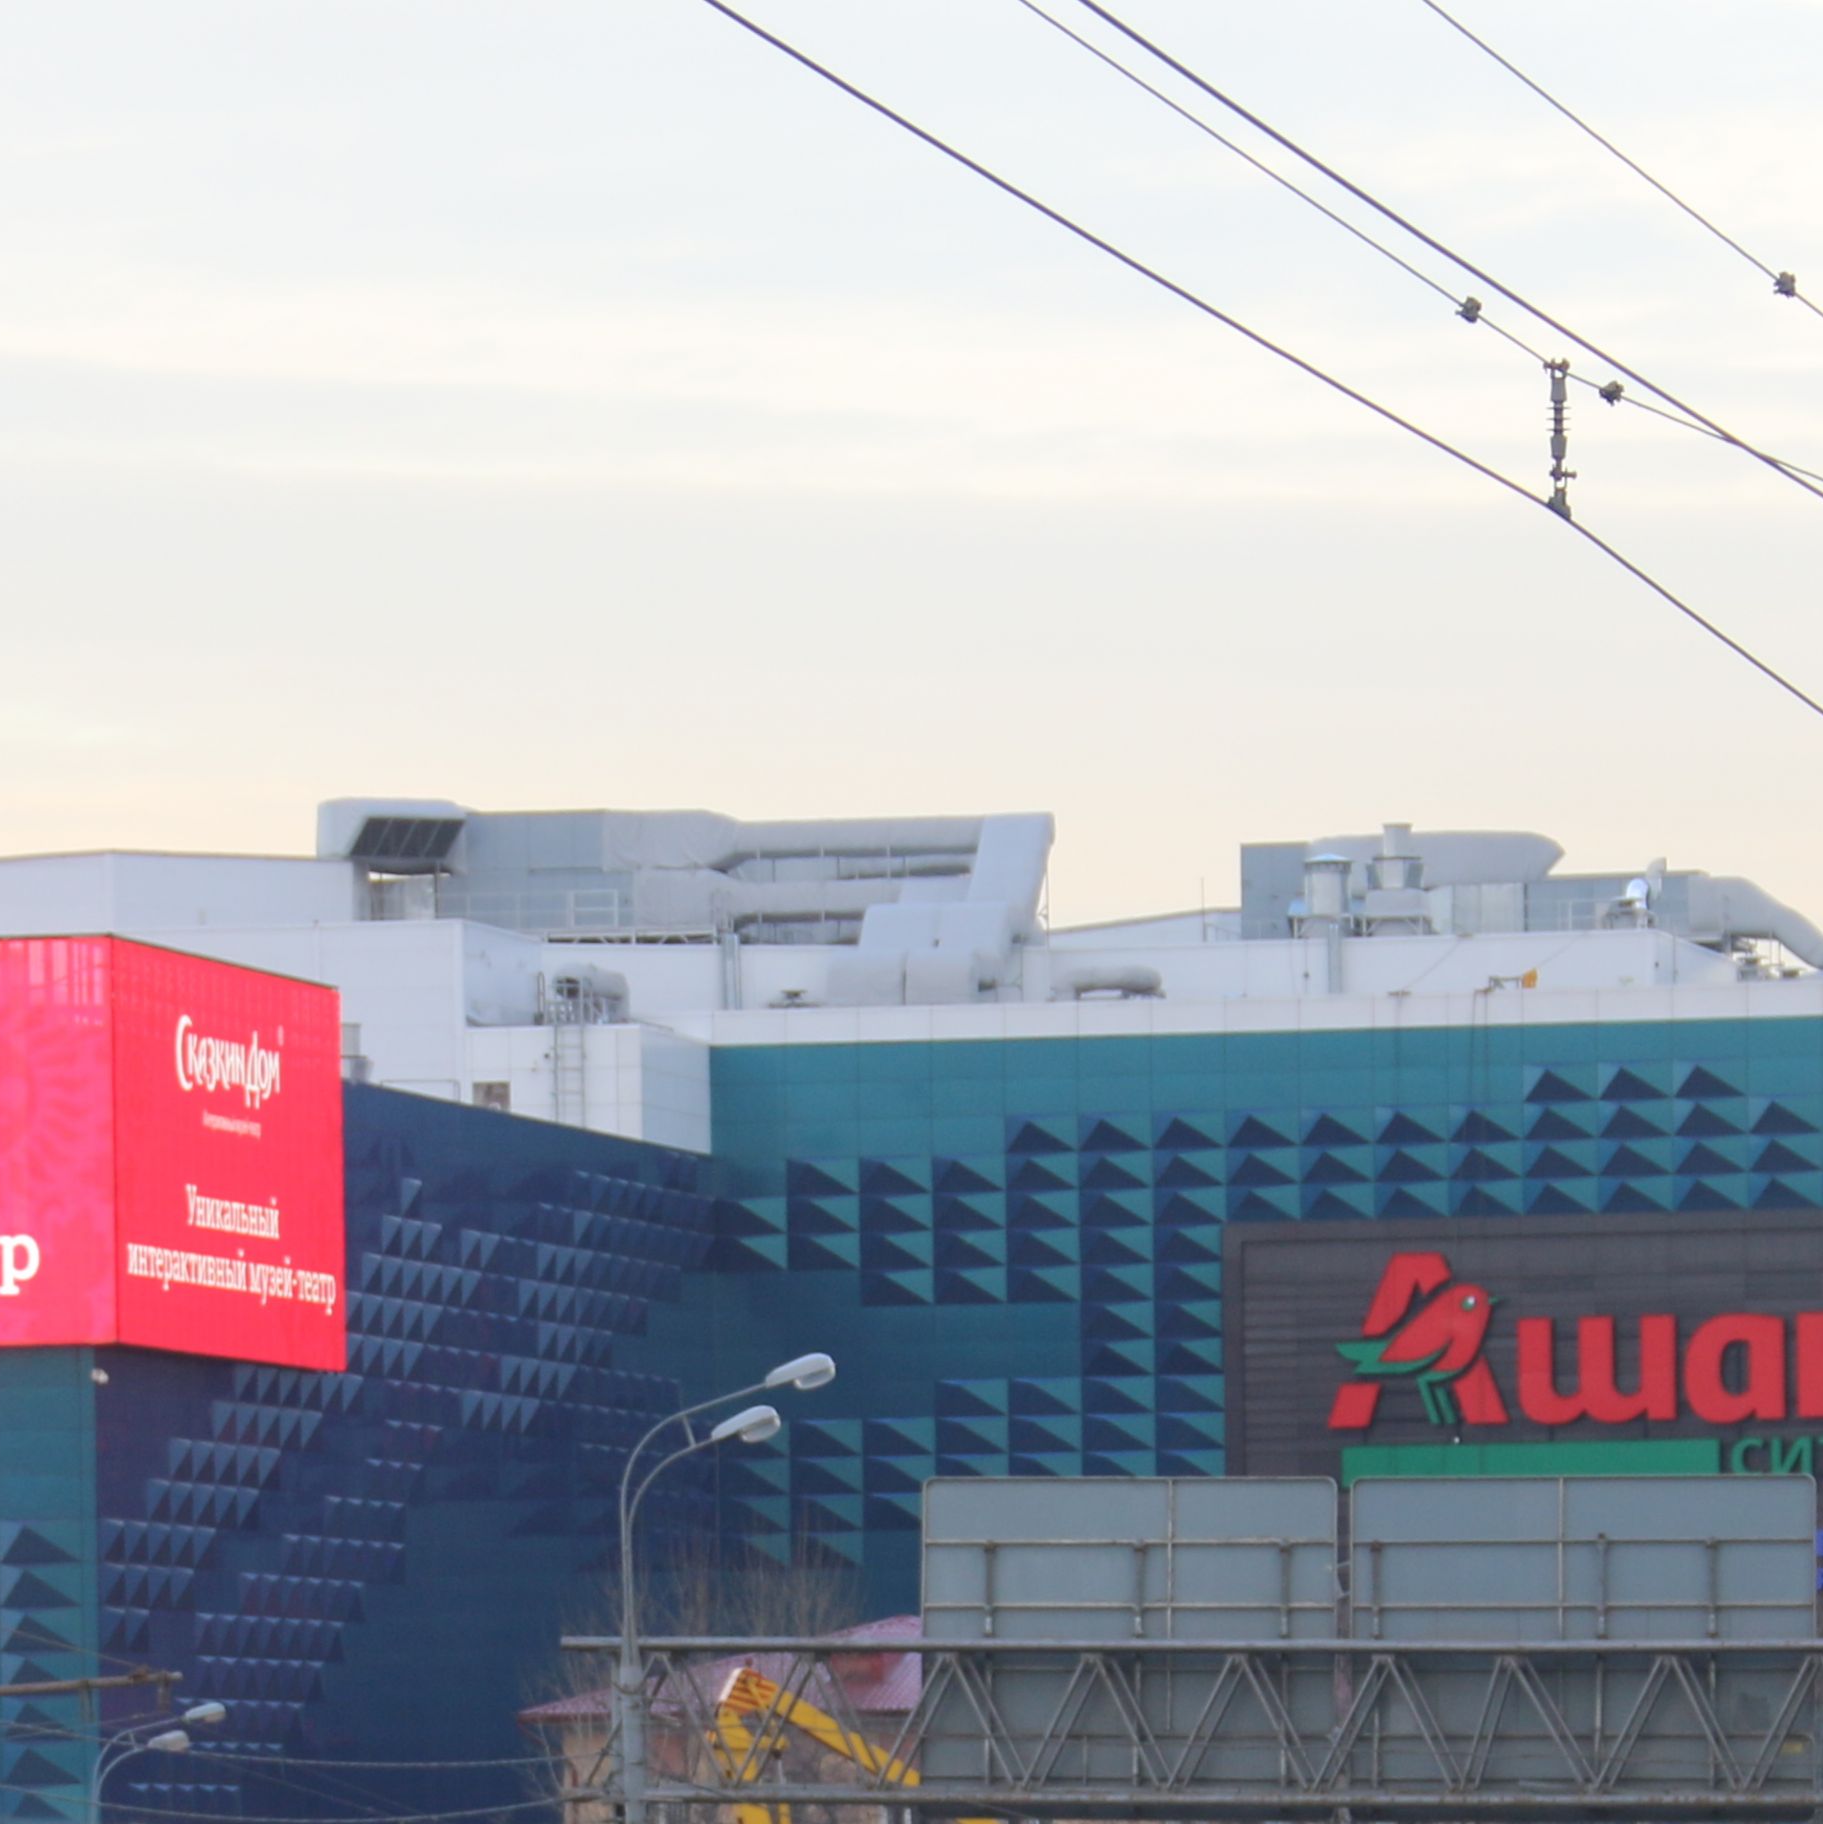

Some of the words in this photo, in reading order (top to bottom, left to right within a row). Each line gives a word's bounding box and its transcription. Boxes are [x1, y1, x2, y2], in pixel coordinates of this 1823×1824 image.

[186, 1183, 280, 1240] Уникальный
[127, 1243, 247, 1293] интерактивный
[249, 1255, 336, 1316] музей-театр
